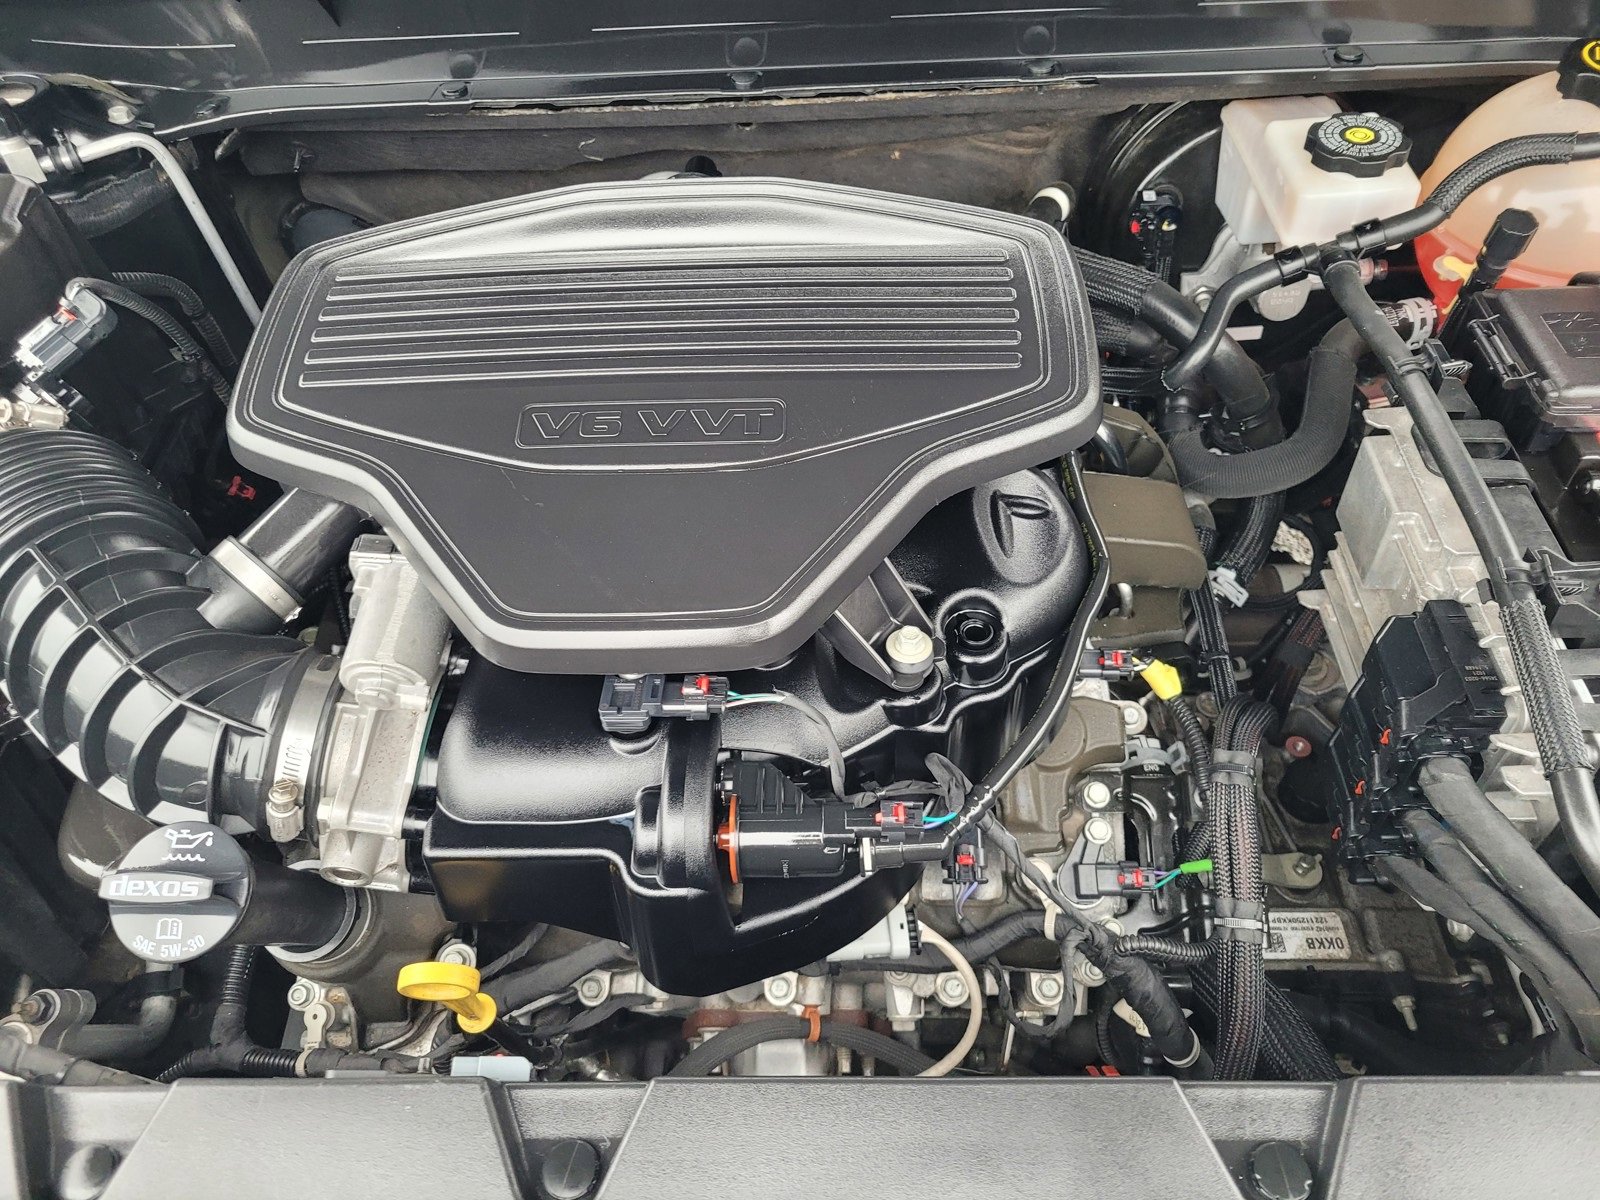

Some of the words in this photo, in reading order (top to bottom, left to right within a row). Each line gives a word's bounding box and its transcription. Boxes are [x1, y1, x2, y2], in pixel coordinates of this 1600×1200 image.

[532, 411, 622, 439] V6
[637, 408, 774, 436] VVT
[133, 935, 157, 955] SAE
[160, 935, 205, 957] 5W-30
